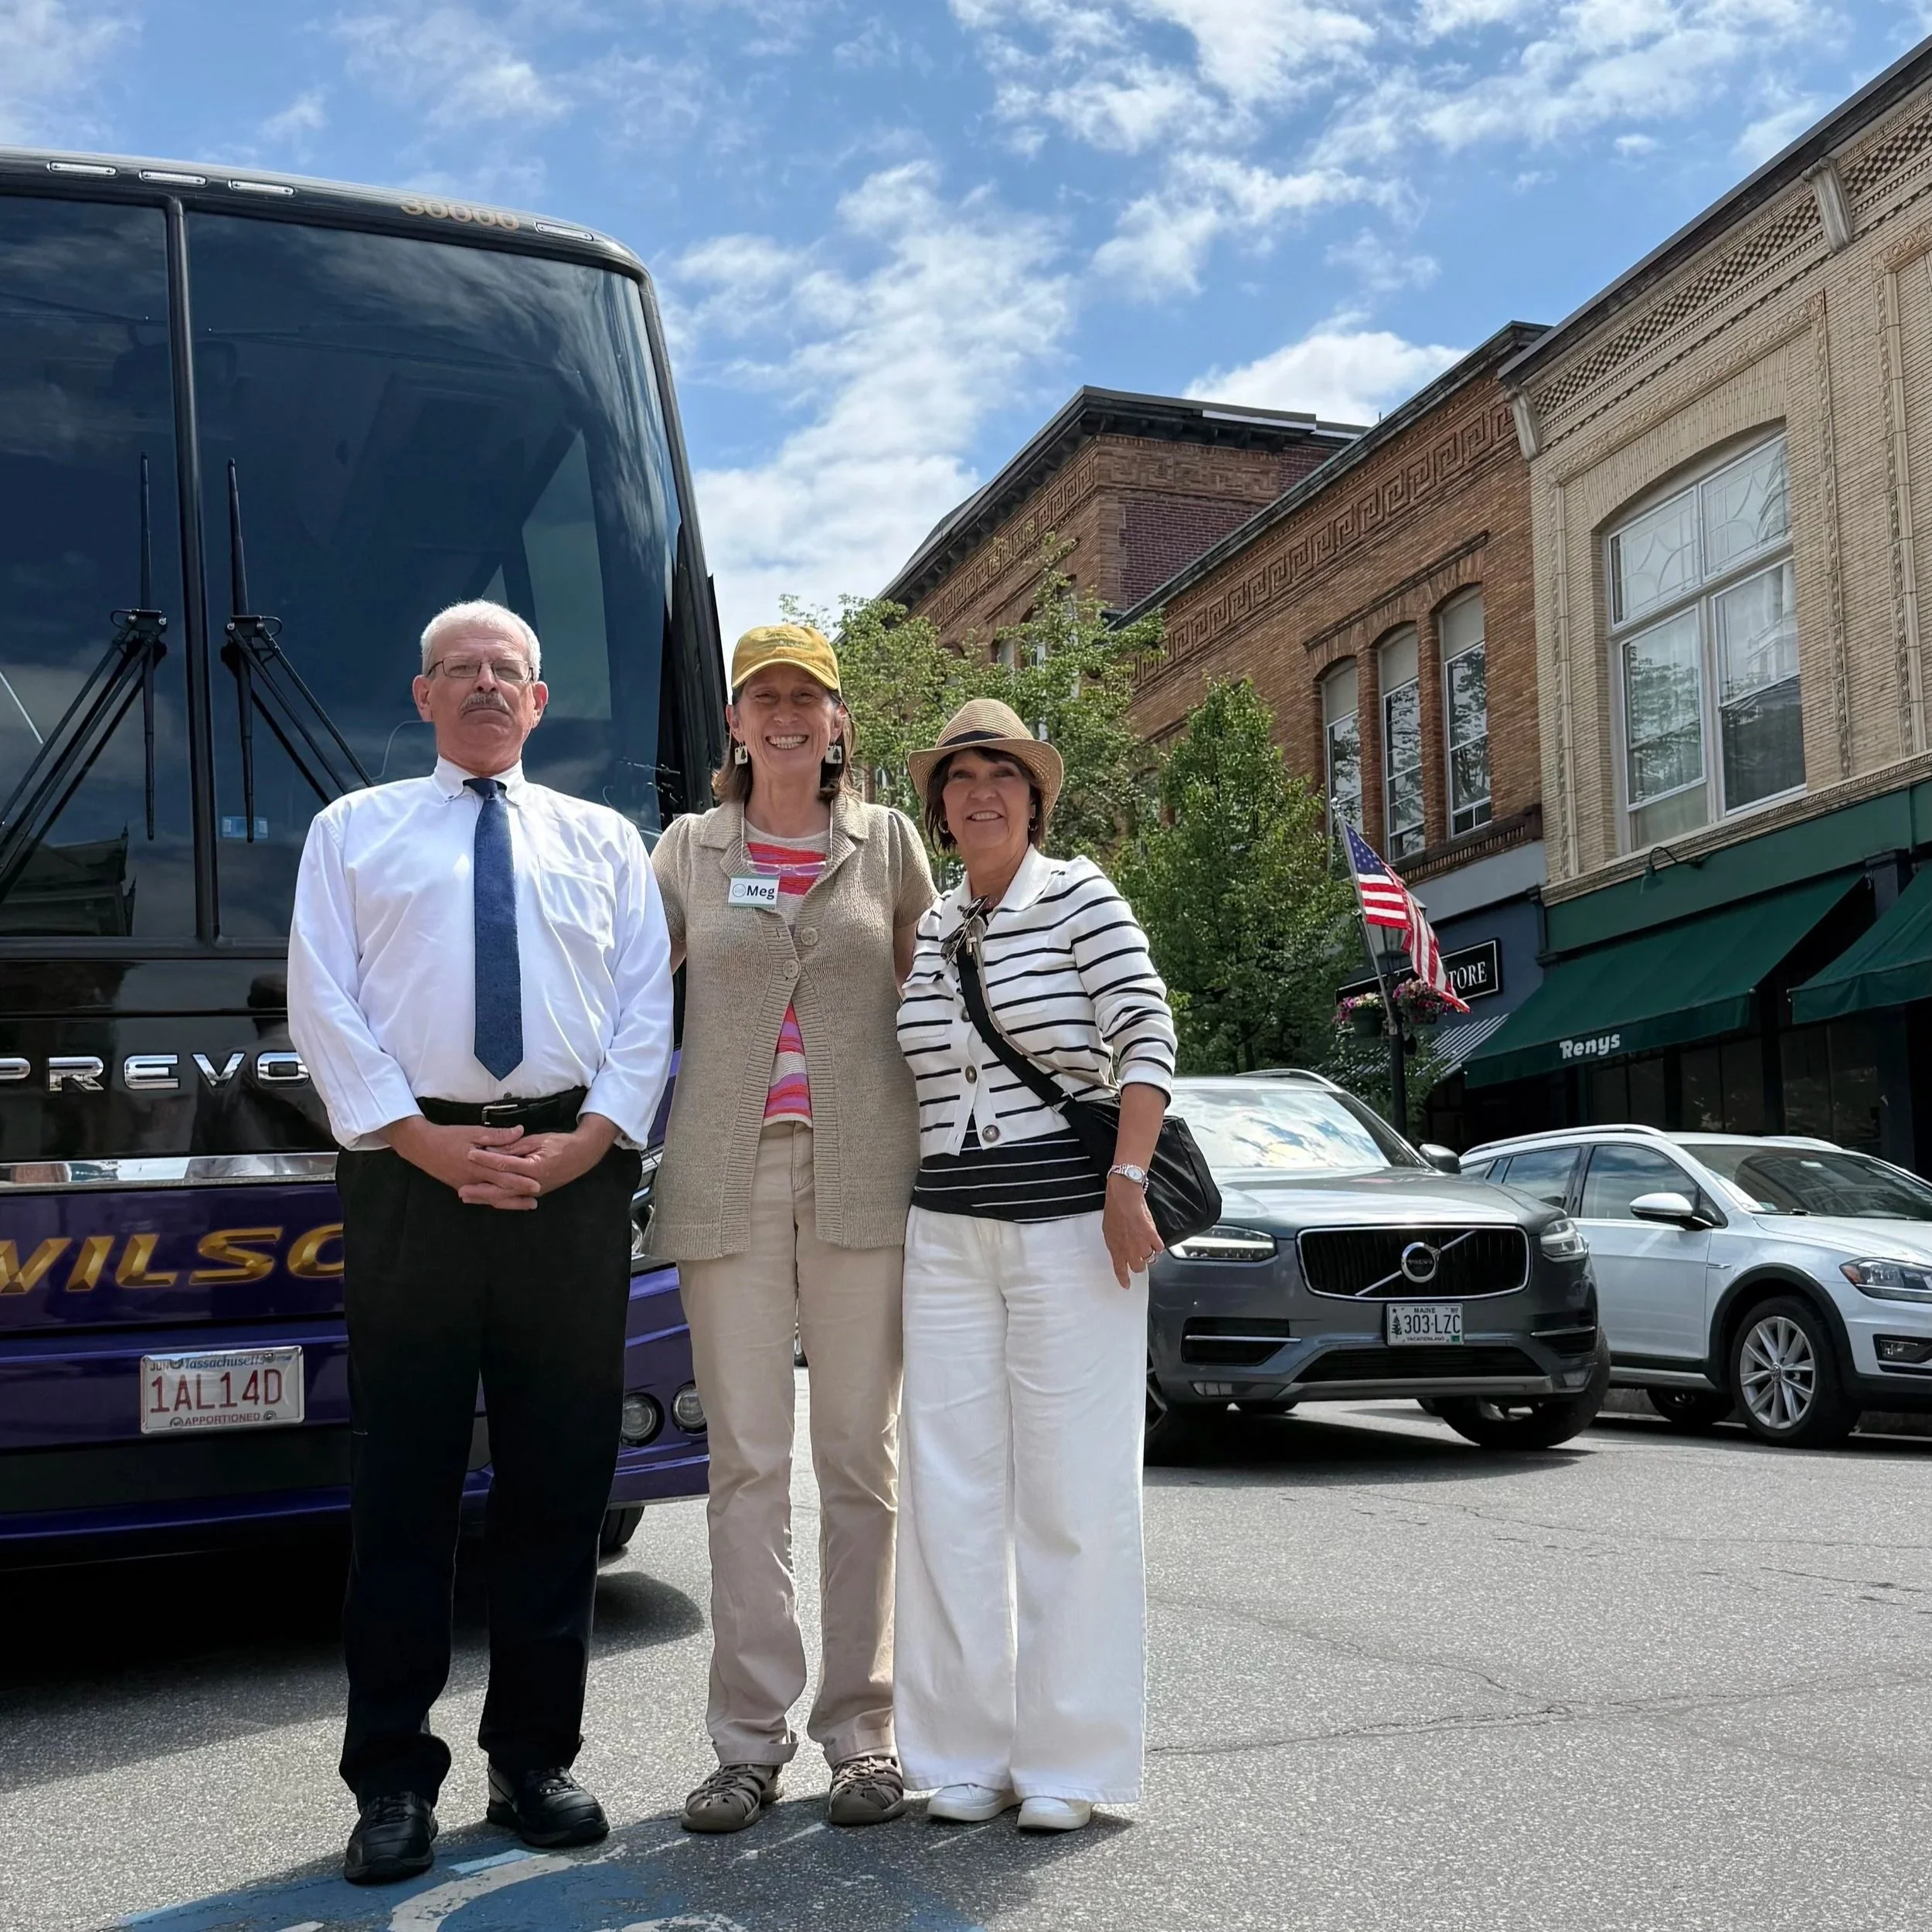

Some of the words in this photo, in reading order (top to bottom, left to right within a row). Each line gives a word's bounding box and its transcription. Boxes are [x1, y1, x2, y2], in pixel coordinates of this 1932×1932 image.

[747, 885, 775, 900] Meg
[1560, 1034, 1621, 1060] Renys
[150, 1369, 283, 1413] 1AL14D
[185, 1413, 260, 1426] APPORTIONED
